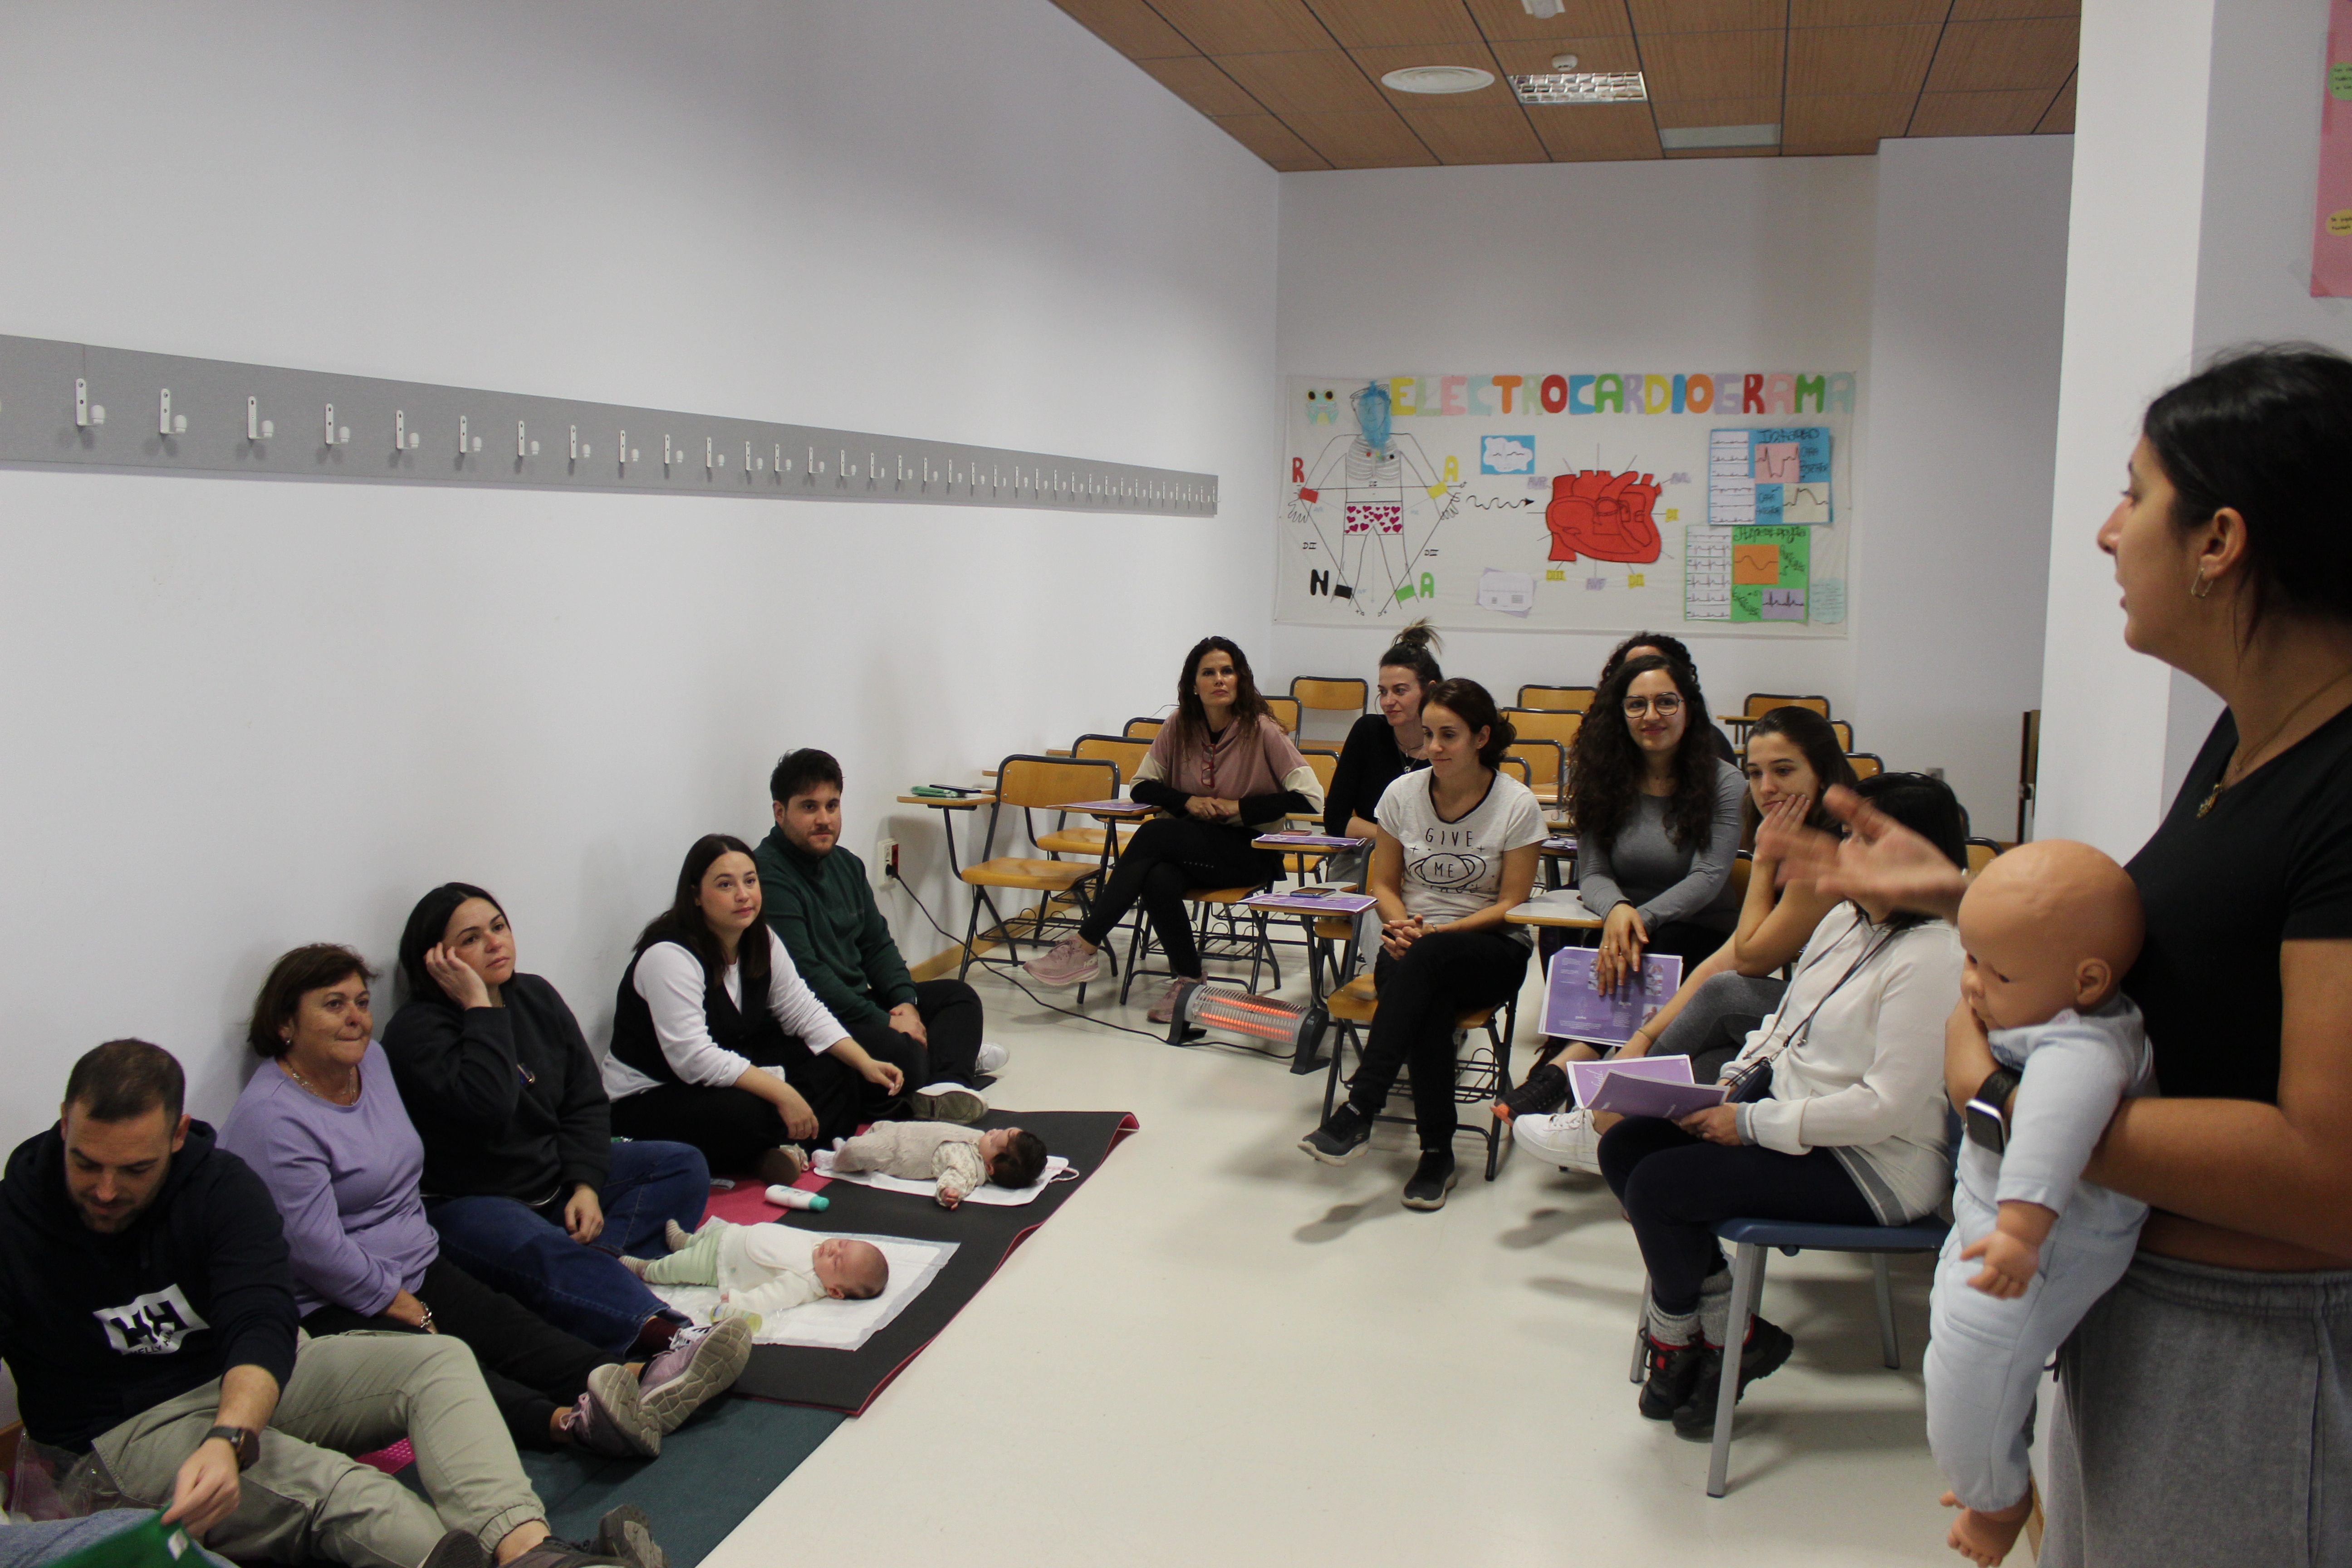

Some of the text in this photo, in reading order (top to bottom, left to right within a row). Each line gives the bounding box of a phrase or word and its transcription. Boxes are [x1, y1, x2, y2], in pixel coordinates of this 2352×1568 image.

[1390, 373, 1857, 416] ELECTROCARDIOGRAMA
[1292, 457, 1304, 483] R
[1443, 455, 1459, 482] A
[1310, 569, 1329, 596] N
[1420, 572, 1435, 598] A
[1426, 828, 1473, 847] GIVE
[1434, 862, 1454, 878] ME
